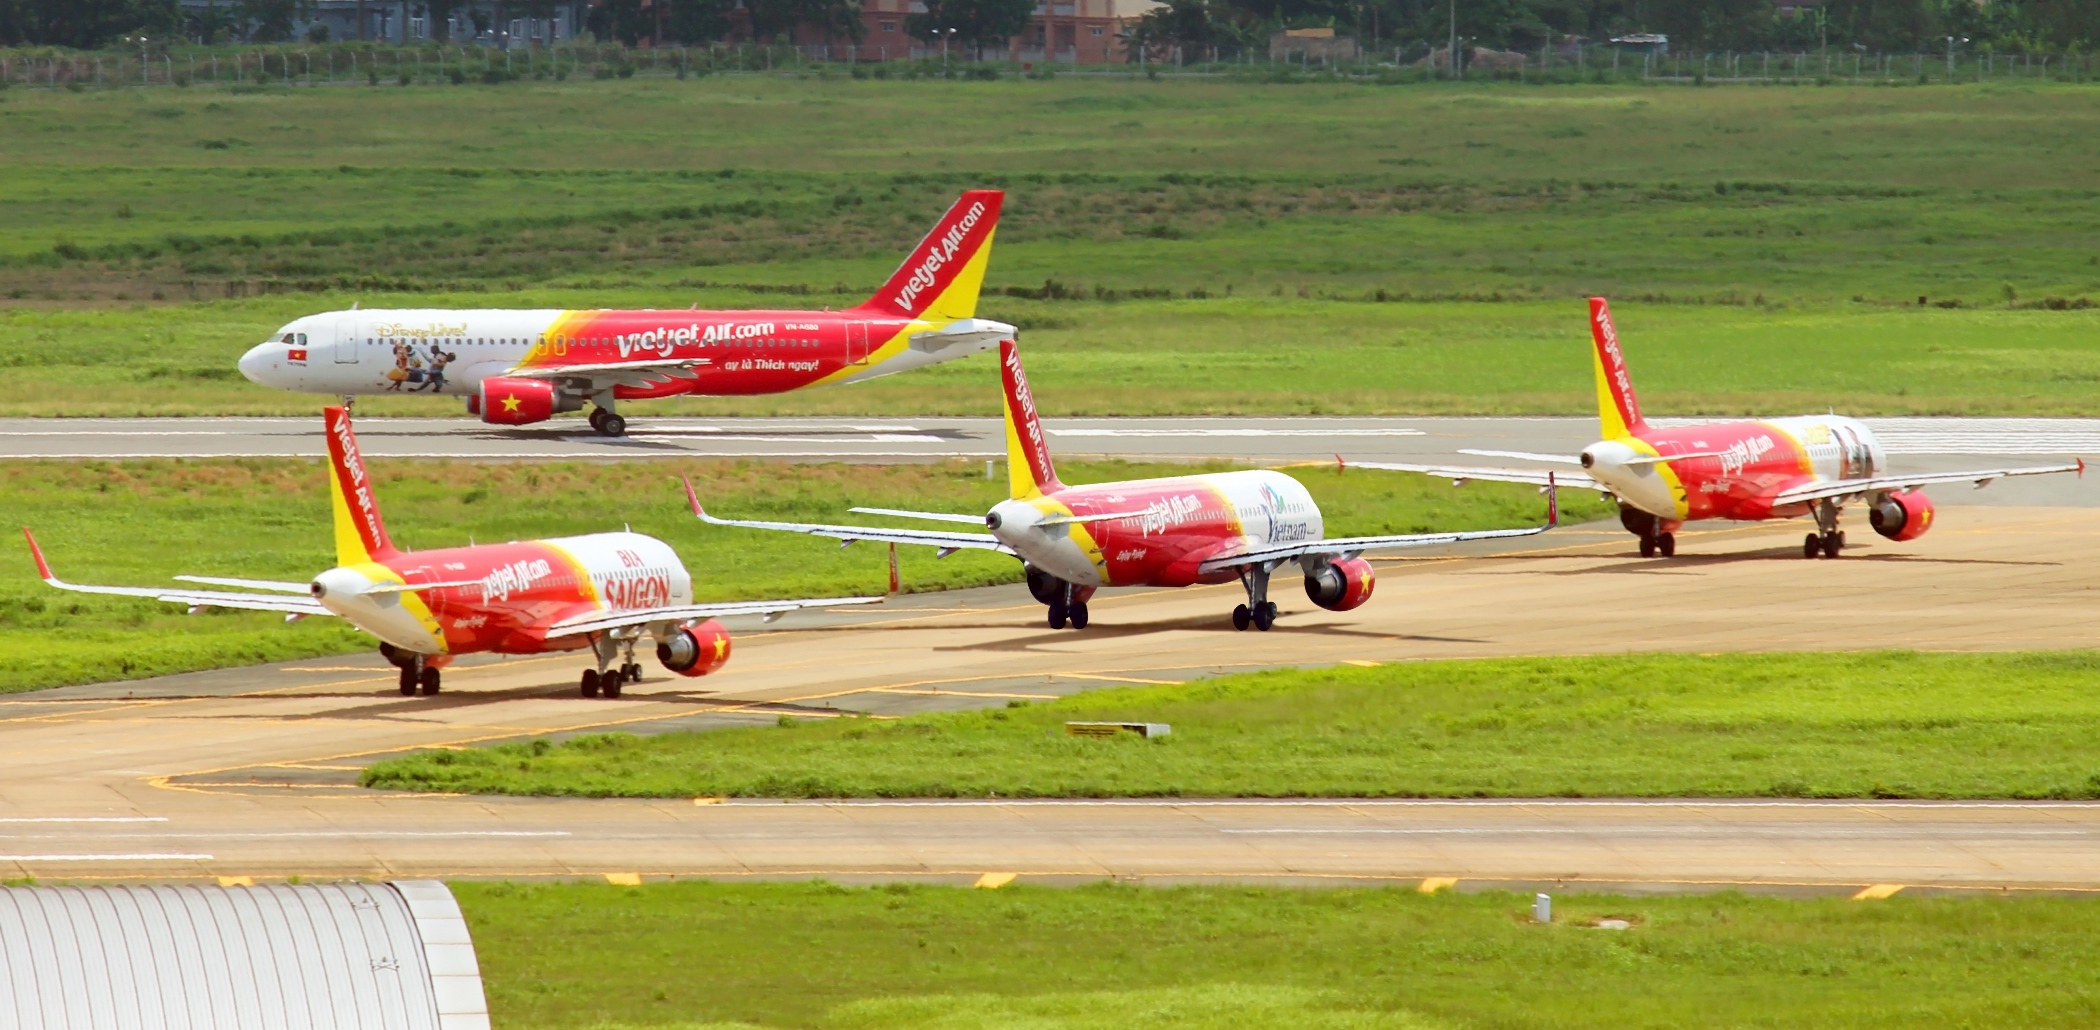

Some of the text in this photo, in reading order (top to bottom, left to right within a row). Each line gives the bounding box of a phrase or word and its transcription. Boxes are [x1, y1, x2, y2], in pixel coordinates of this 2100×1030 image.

[788, 360, 819, 372] ngay!
[1260, 503, 1307, 544] Vietnam
[616, 549, 645, 568] BIA
[605, 575, 670, 609] SAIGON
